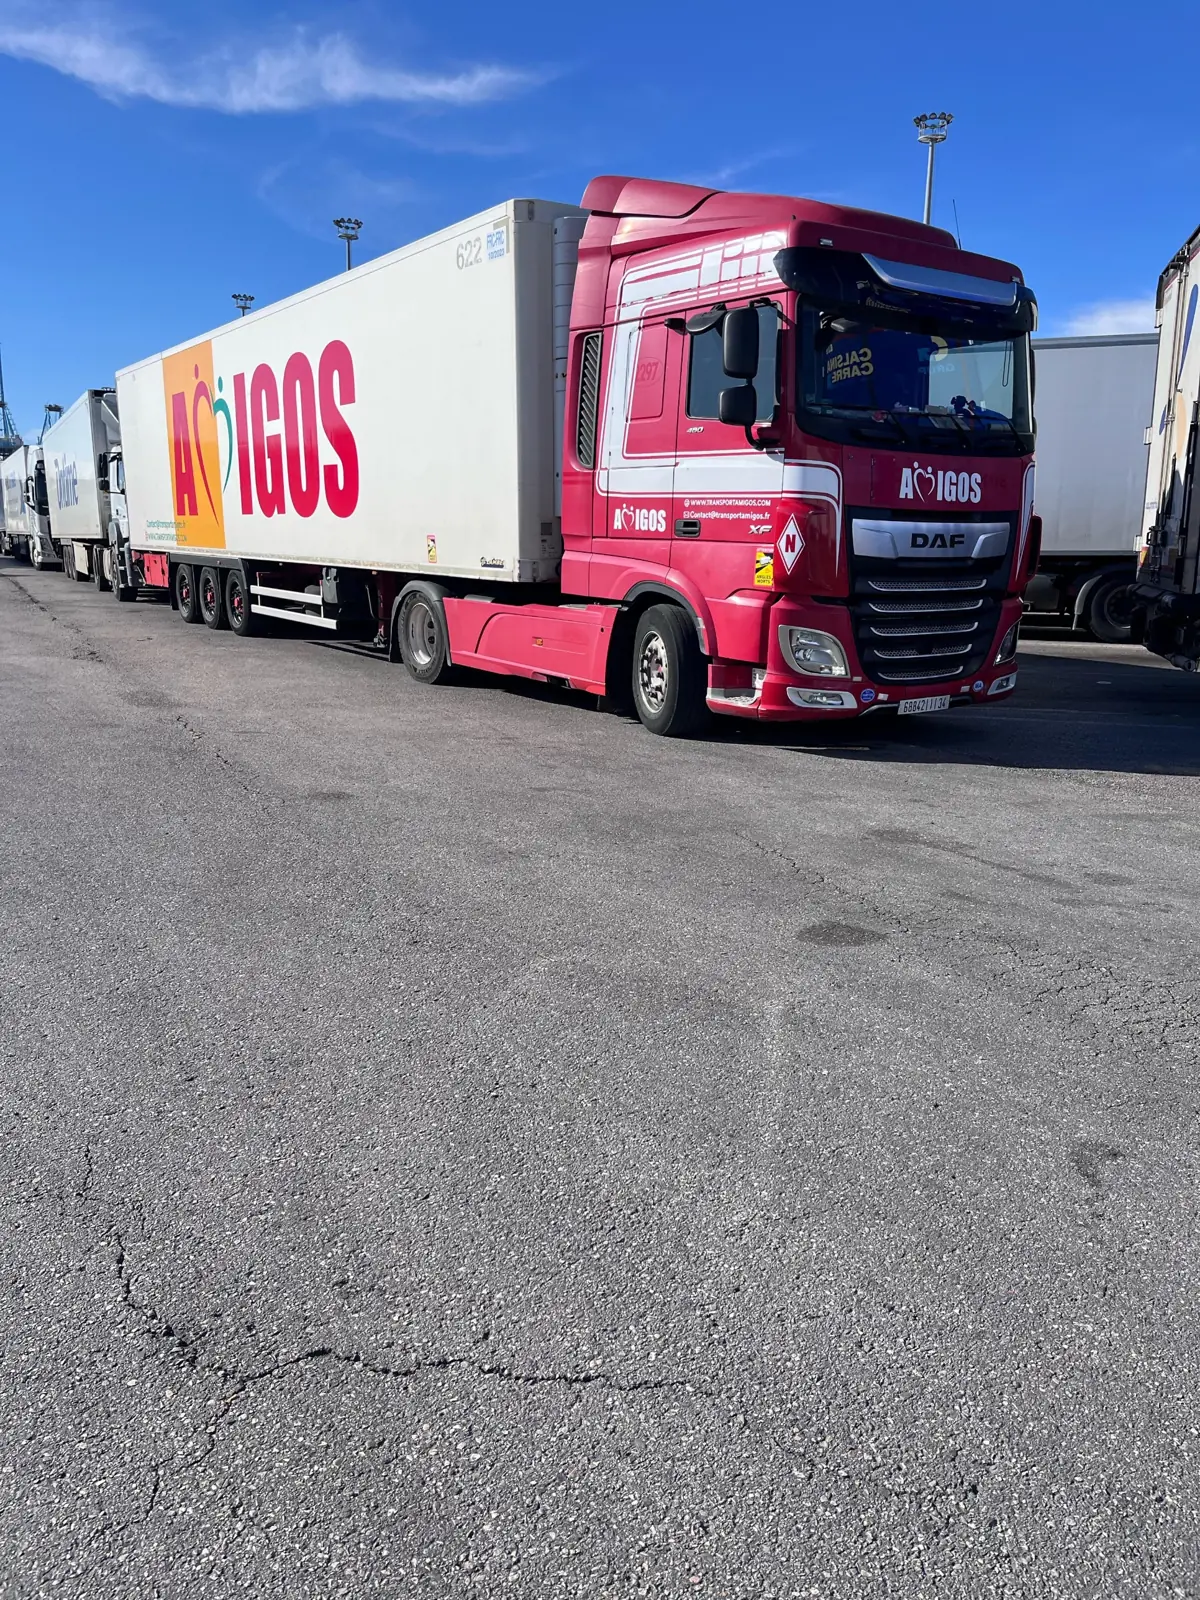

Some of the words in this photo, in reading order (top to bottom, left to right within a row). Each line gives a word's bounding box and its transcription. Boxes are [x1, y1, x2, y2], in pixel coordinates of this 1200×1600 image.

[456, 236, 482, 270] 622
[172, 340, 359, 525] AMIGOS
[899, 462, 982, 504] AMIGOS
[690, 499, 771, 507] WWW.TRANSPORTAMIGOS.COM
[613, 503, 666, 532] AMIGOS
[689, 511, 771, 521] Contact@transportamigos.fr
[748, 525, 773, 535] XF
[785, 534, 796, 553] N
[910, 533, 965, 549] DAF
